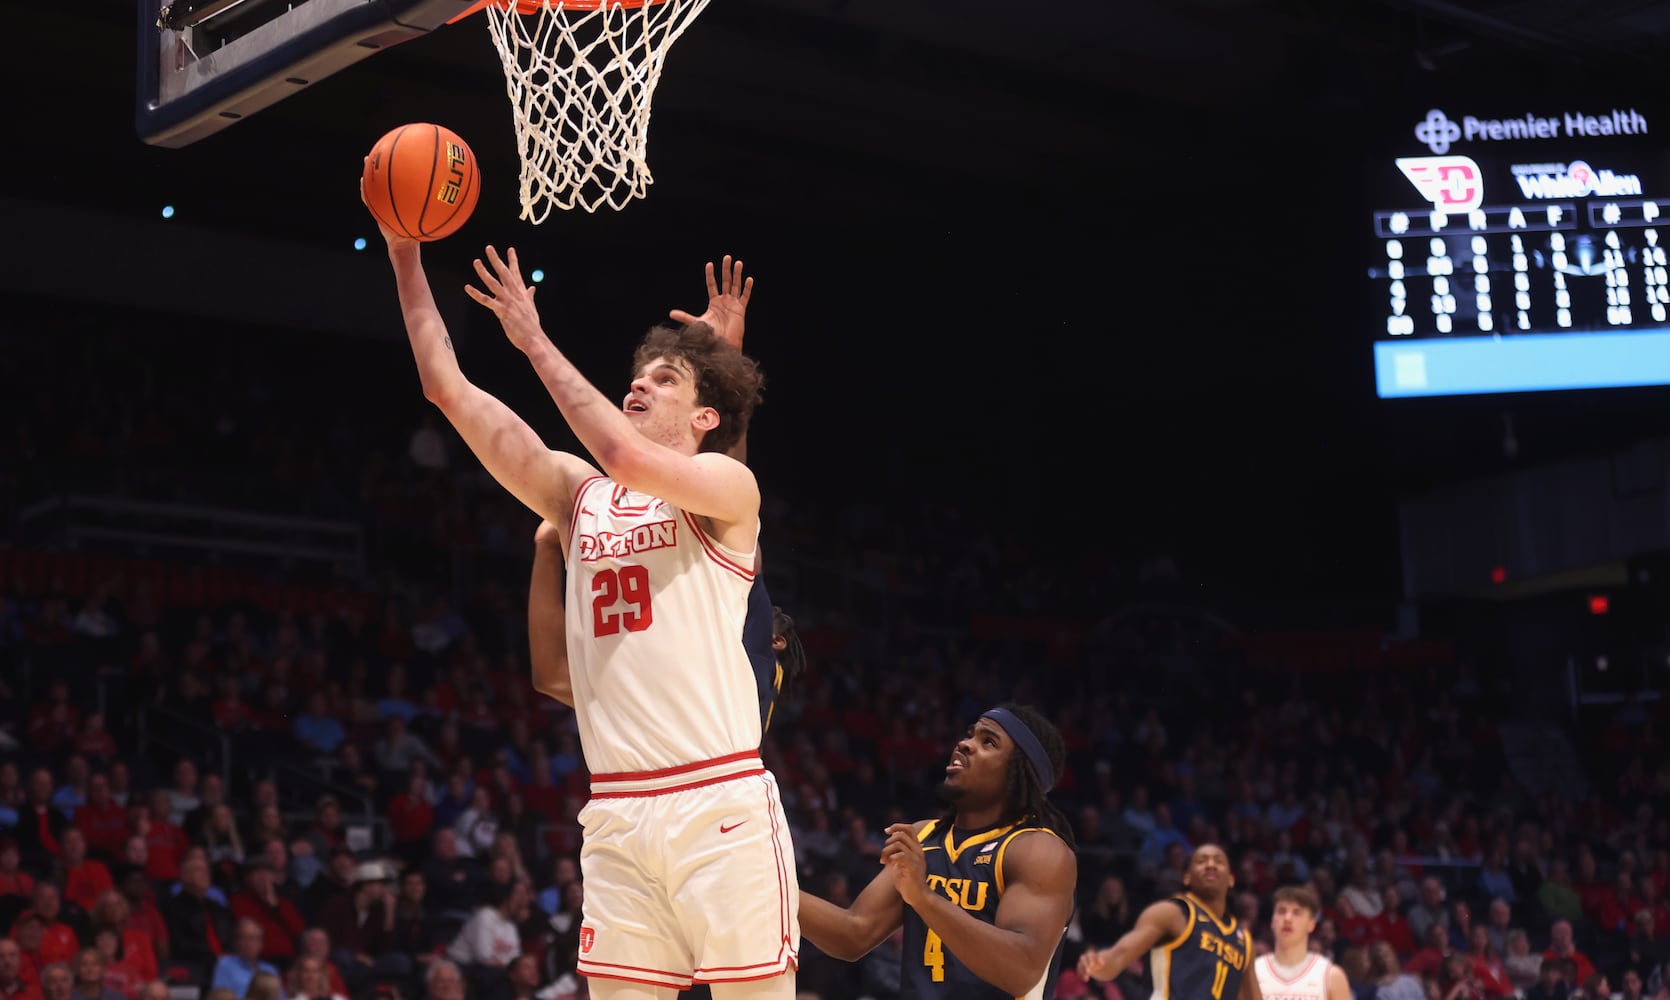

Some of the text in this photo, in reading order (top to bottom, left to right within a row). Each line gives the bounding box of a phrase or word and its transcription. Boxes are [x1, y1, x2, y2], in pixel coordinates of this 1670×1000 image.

[1462, 107, 1649, 142] Premier Health
[442, 142, 465, 205] ELITE
[592, 564, 653, 638] 29
[926, 873, 989, 911] TSU
[924, 928, 945, 982] 4
[1200, 930, 1245, 971] ETSU
[1211, 959, 1229, 1000] 11
